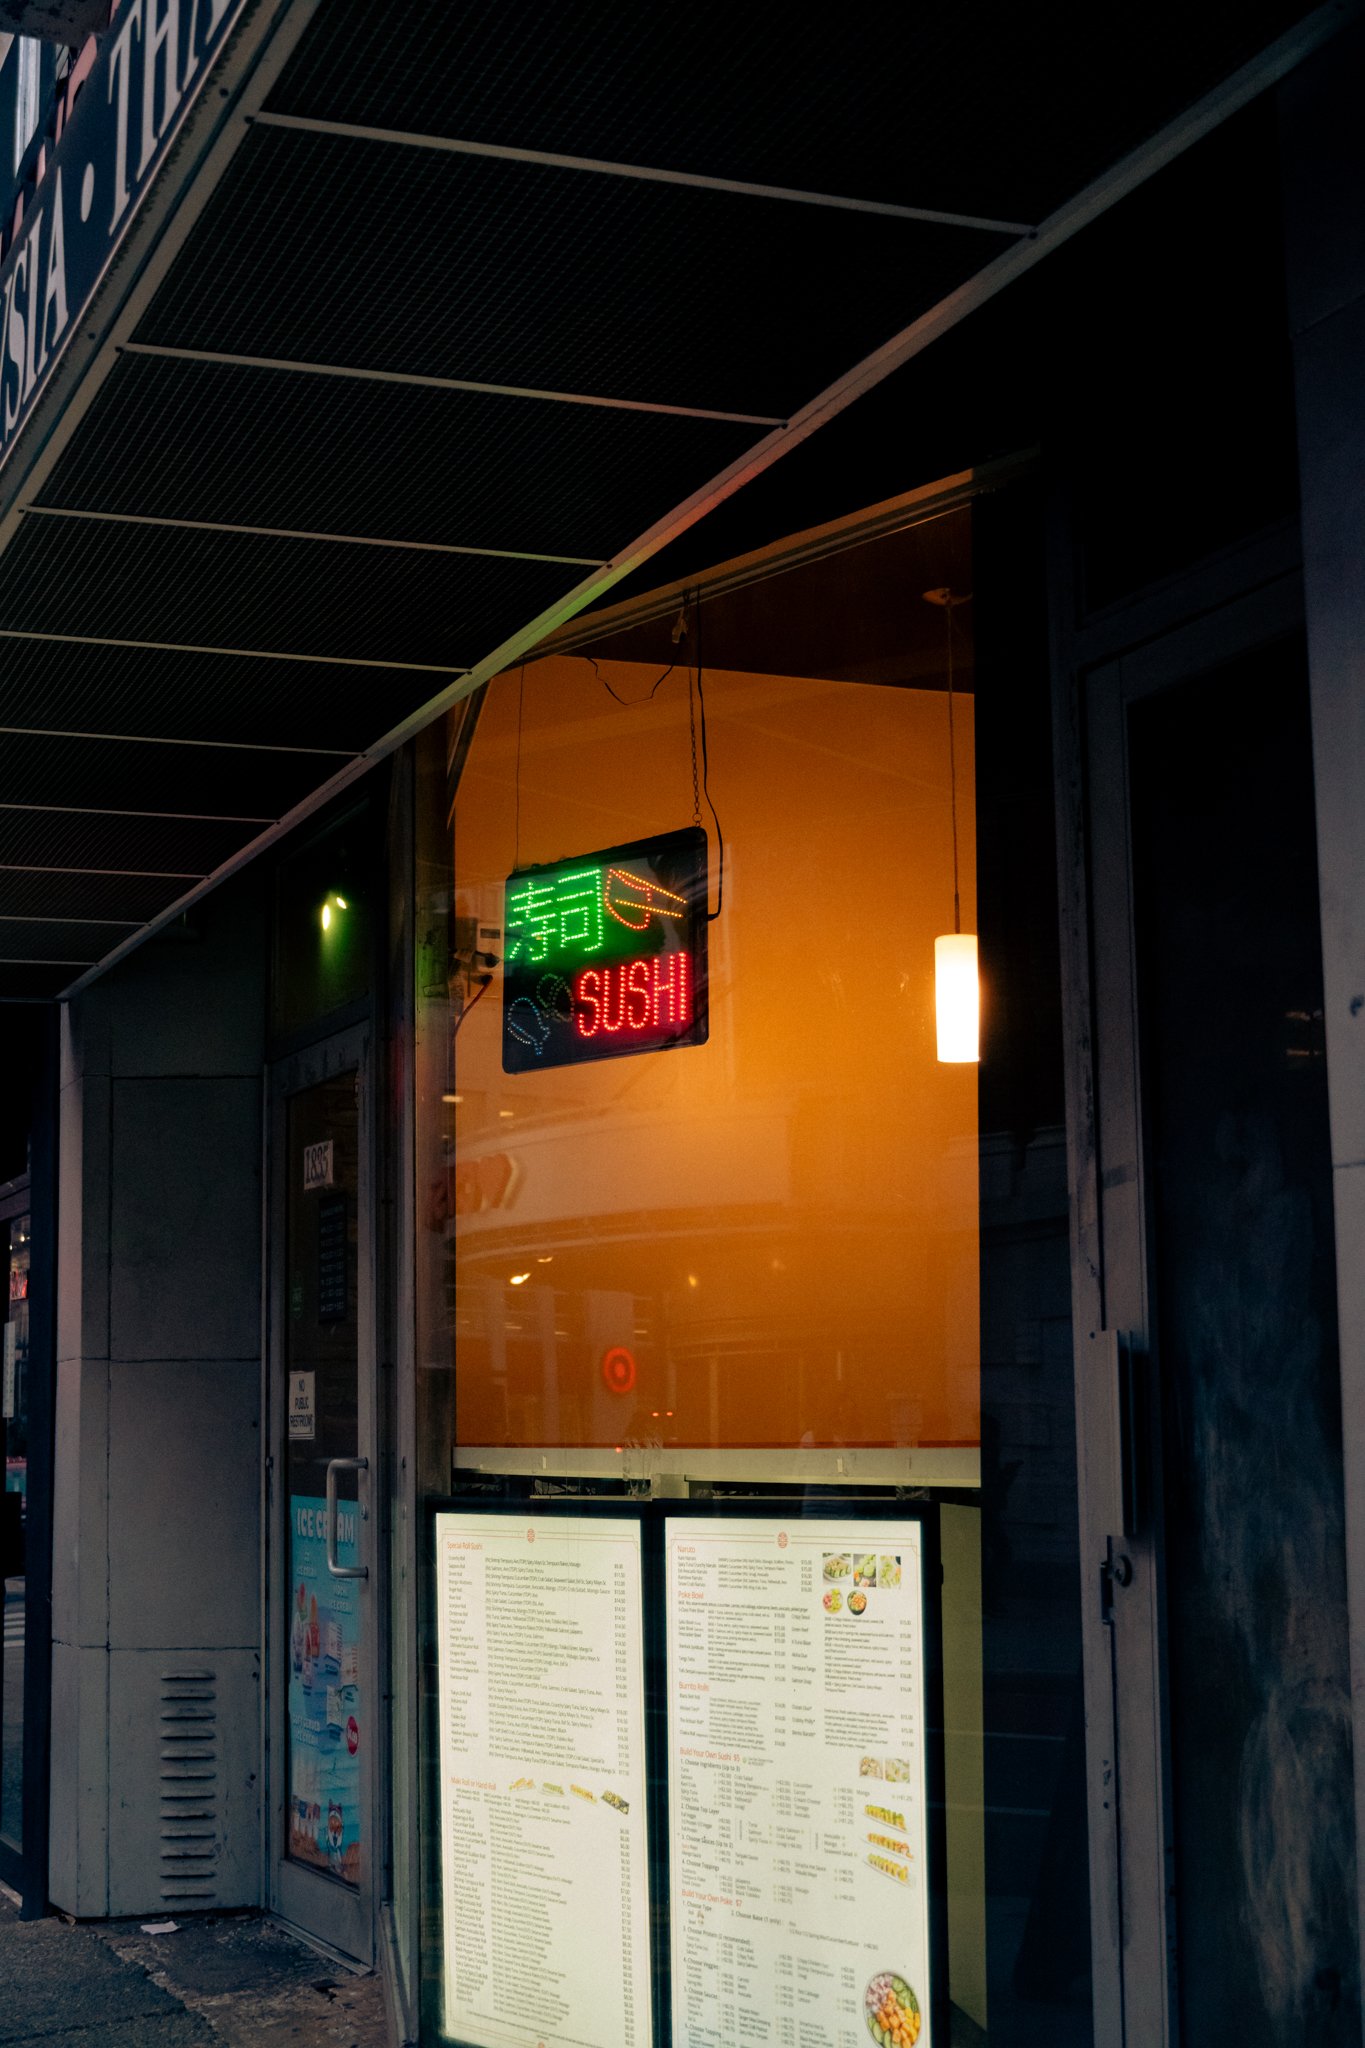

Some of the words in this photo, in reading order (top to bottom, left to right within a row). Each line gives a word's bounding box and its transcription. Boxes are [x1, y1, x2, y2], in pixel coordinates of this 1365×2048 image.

[508, 868, 603, 961] 寿司
[578, 951, 687, 1038] SUSHI
[295, 1397, 310, 1410] PUBLIC
[297, 1507, 314, 1538] ICE
[315, 1509, 355, 1544] CRAM
[679, 1682, 696, 1690] Burrito
[693, 1749, 704, 1757] Your
[705, 1750, 717, 1758] Own
[718, 1752, 731, 1761] Sushi
